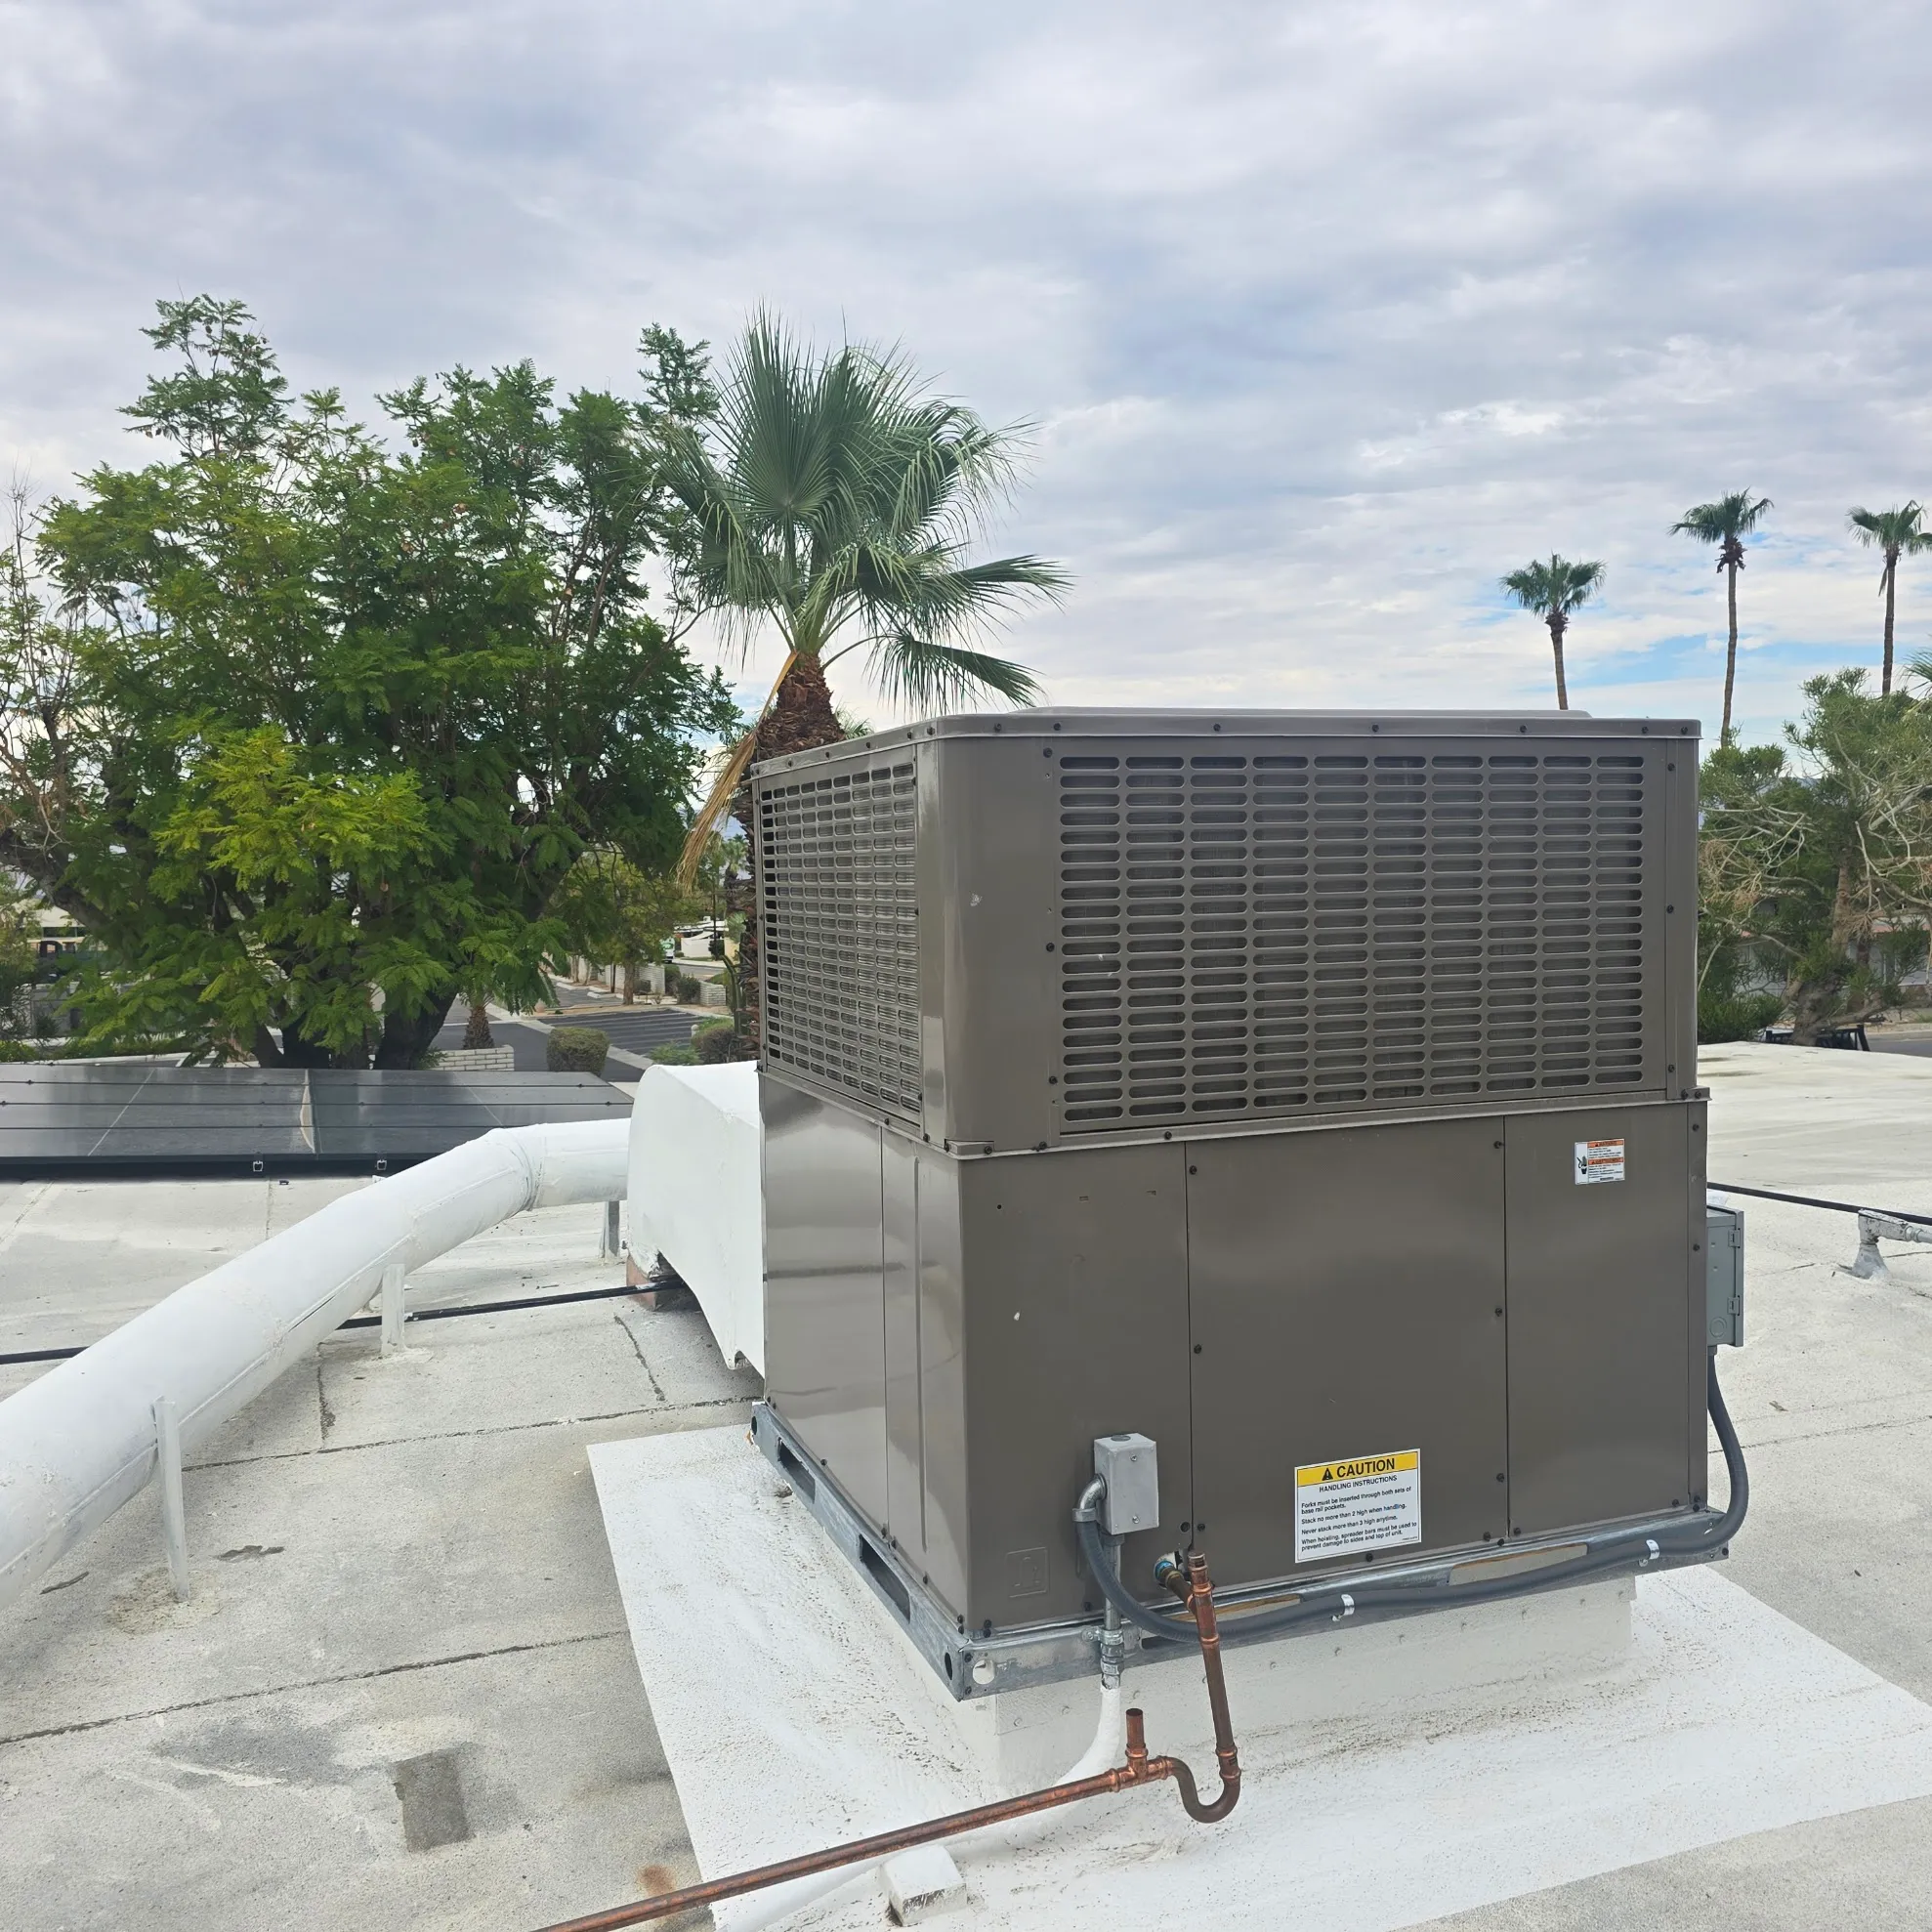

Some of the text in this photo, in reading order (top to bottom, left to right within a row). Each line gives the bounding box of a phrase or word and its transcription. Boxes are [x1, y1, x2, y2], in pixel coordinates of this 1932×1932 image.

[1337, 1458, 1395, 1477] CAUTION
[1320, 1475, 1397, 1492] HANDLING INSTRUCTIONS
[1339, 1493, 1360, 1502] inserted
[1361, 1491, 1380, 1499] through
[1357, 1509, 1367, 1518] high
[1341, 1530, 1364, 1538] spreader
[1301, 1543, 1322, 1552] prevent
[1323, 1539, 1342, 1548] damage
[1375, 1533, 1384, 1541] top
